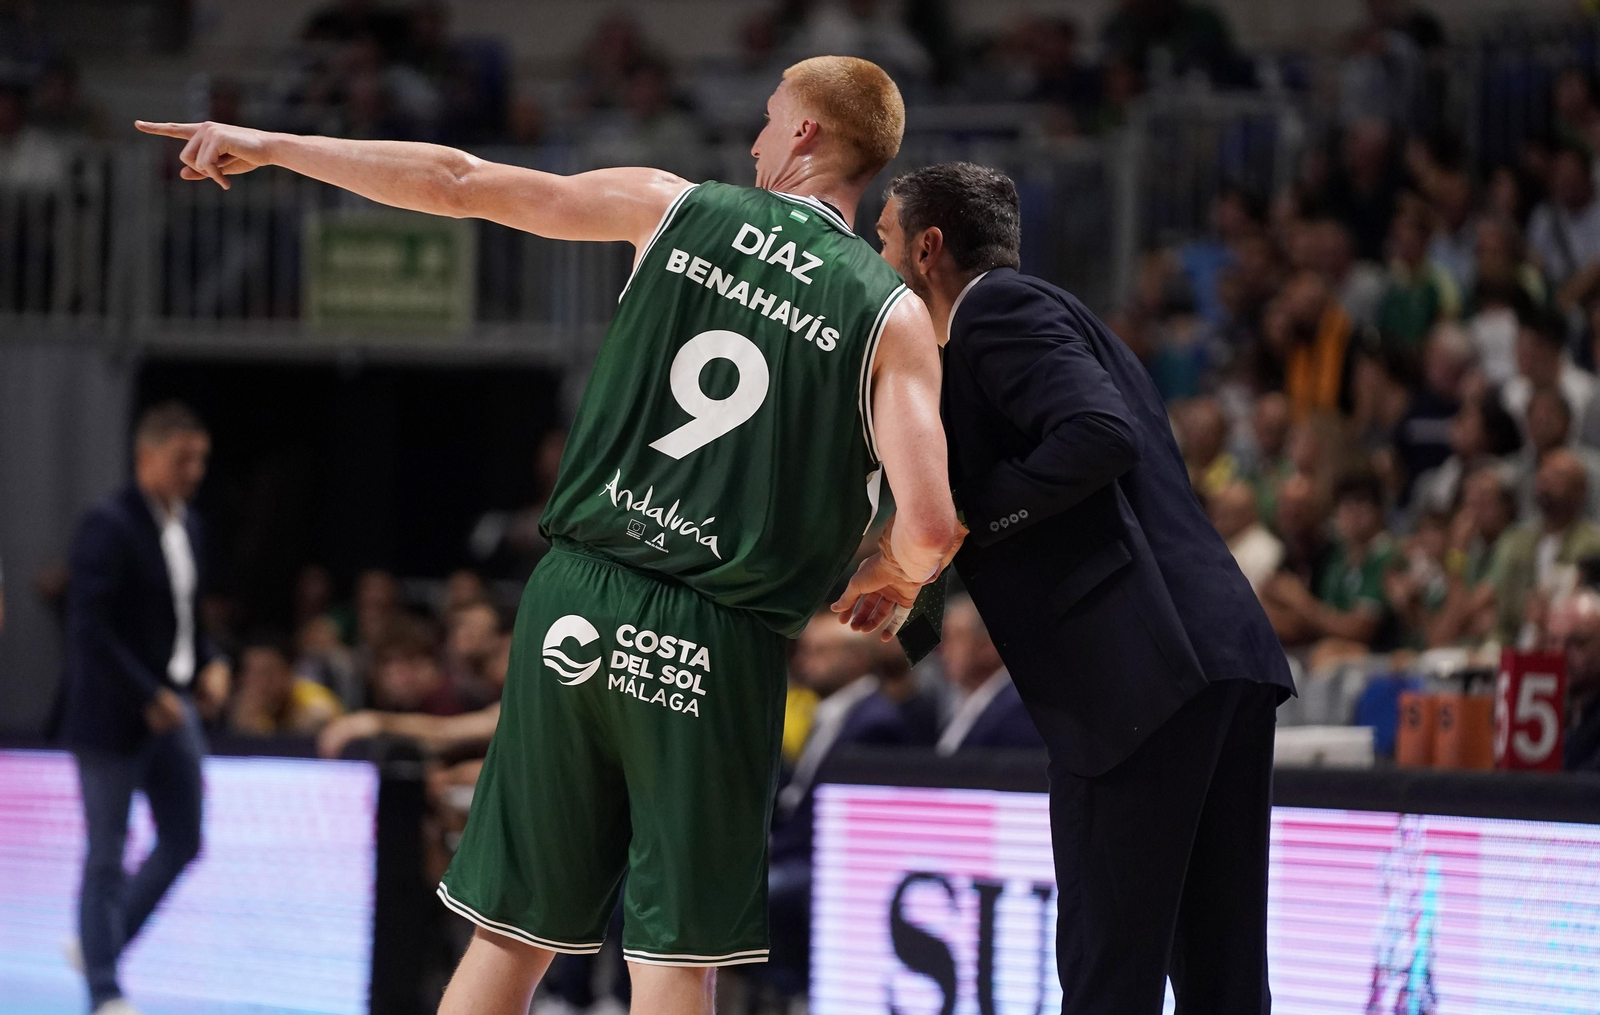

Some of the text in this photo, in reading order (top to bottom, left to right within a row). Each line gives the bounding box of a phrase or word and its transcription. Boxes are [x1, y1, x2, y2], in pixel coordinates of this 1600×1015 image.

[731, 222, 825, 285] DÍAZ
[665, 248, 840, 352] BENAHAVÍS
[649, 329, 770, 460] 9
[598, 468, 722, 560] Andalucía
[610, 650, 707, 696] DEL SOL
[615, 624, 711, 673] COSTA
[607, 673, 700, 718] MÁLAGA
[1514, 673, 1559, 764] 5
